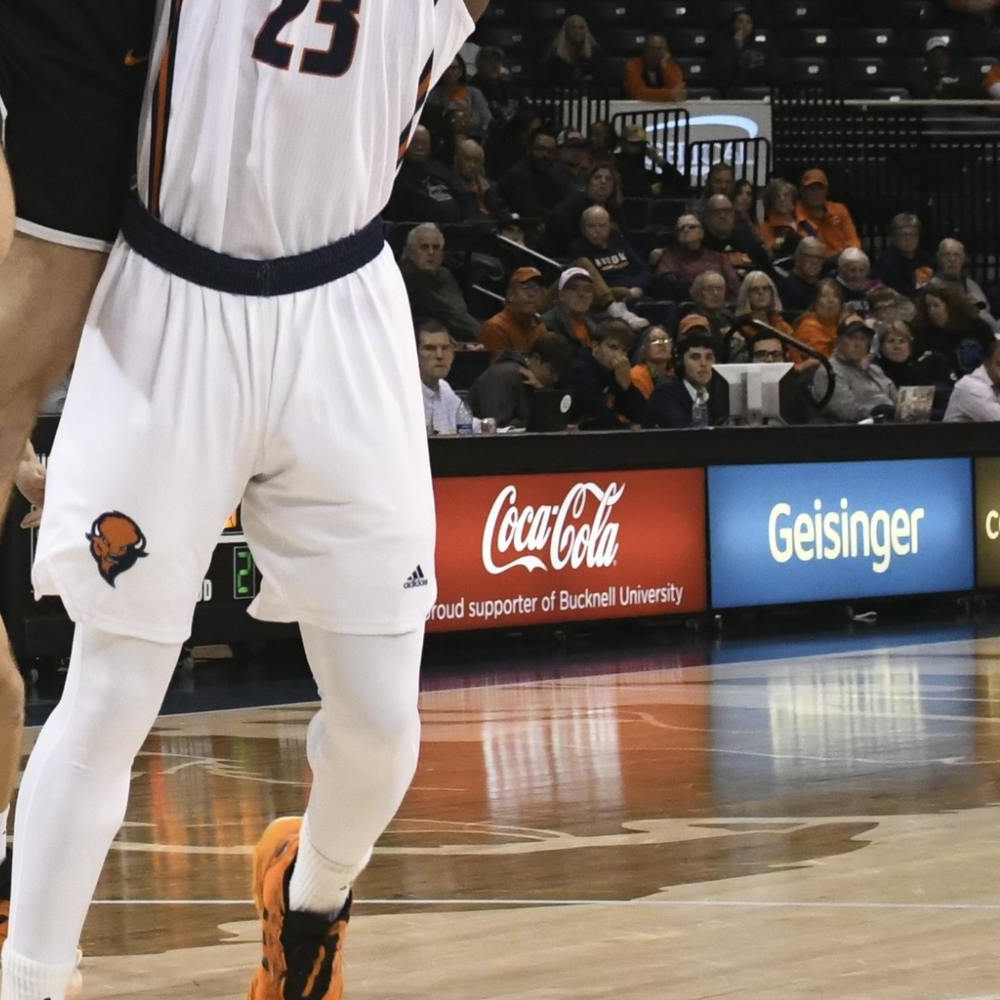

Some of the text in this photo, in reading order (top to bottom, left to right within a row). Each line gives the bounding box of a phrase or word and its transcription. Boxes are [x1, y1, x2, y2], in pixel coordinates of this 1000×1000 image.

[482, 482, 626, 575] Coca-Cola
[768, 497, 925, 573] Geisinger
[403, 578, 428, 589] adidas
[468, 595, 537, 620] supporter
[542, 591, 557, 611] of
[560, 586, 616, 610] Bucknell
[620, 583, 684, 606] University
